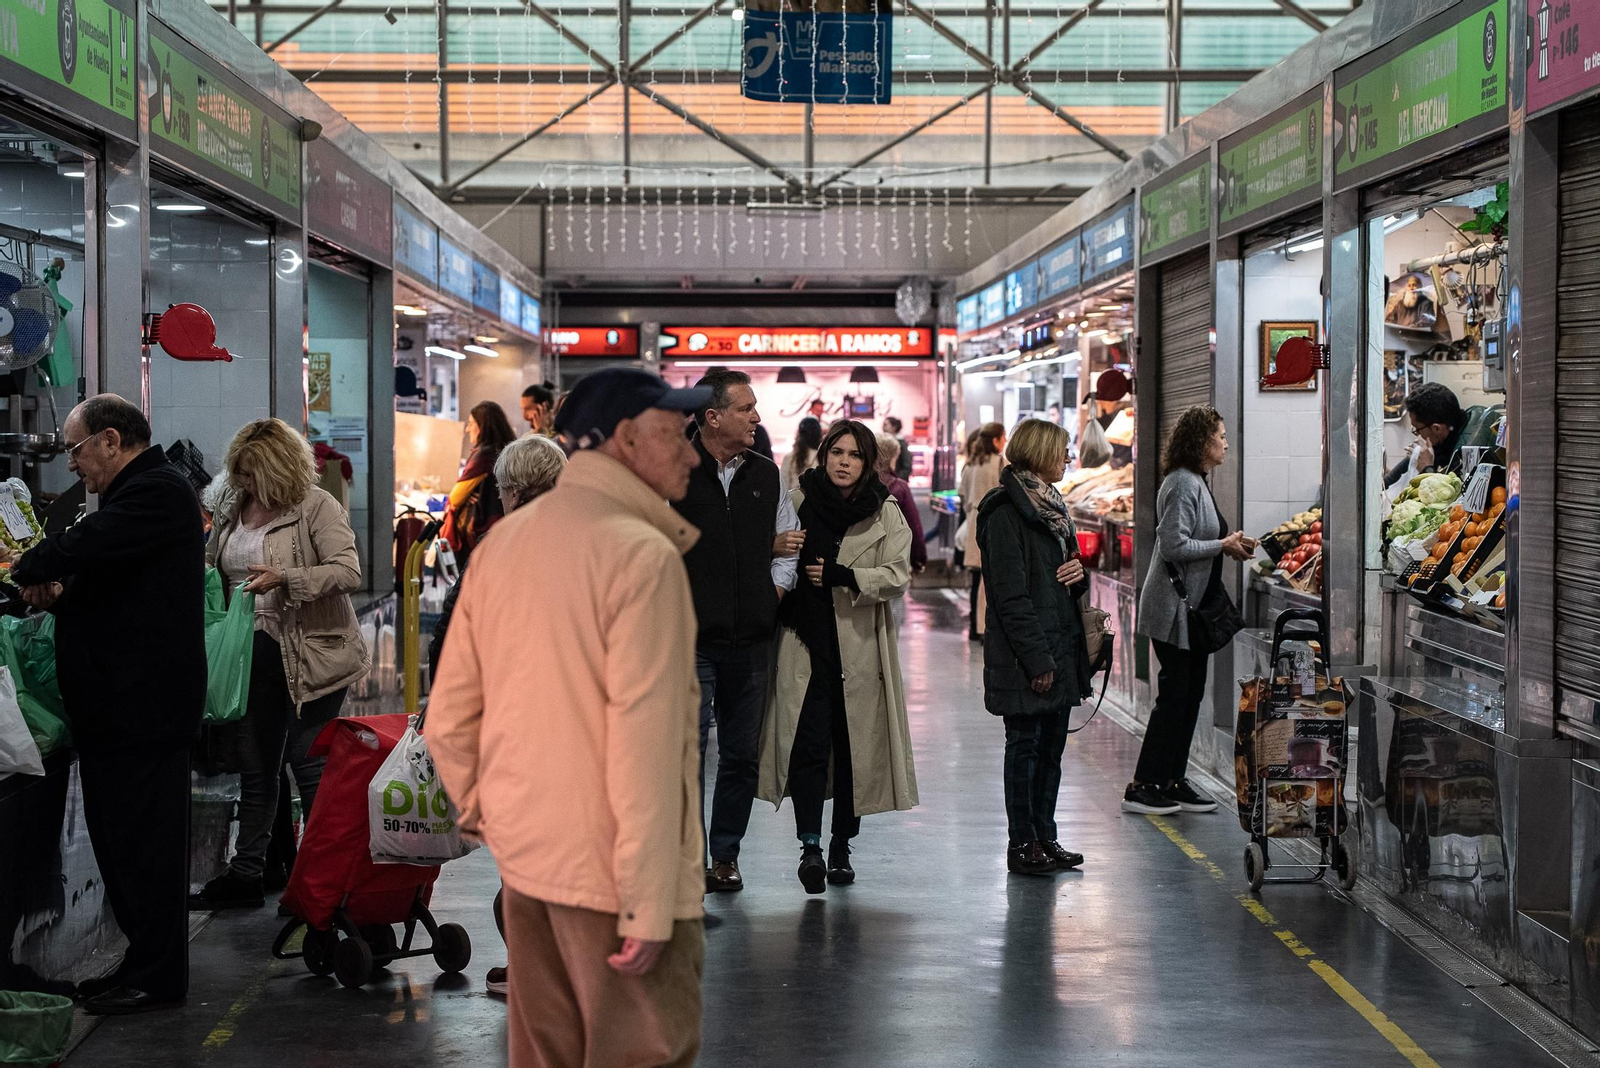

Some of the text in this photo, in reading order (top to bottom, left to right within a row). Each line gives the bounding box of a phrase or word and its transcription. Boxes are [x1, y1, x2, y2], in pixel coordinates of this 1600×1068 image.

[819, 50, 880, 61] Pesado
[1398, 92, 1449, 145] DEL MERCADO
[738, 330, 902, 353] CARNICERÍA RAMOS
[383, 818, 431, 834] 50-70%
